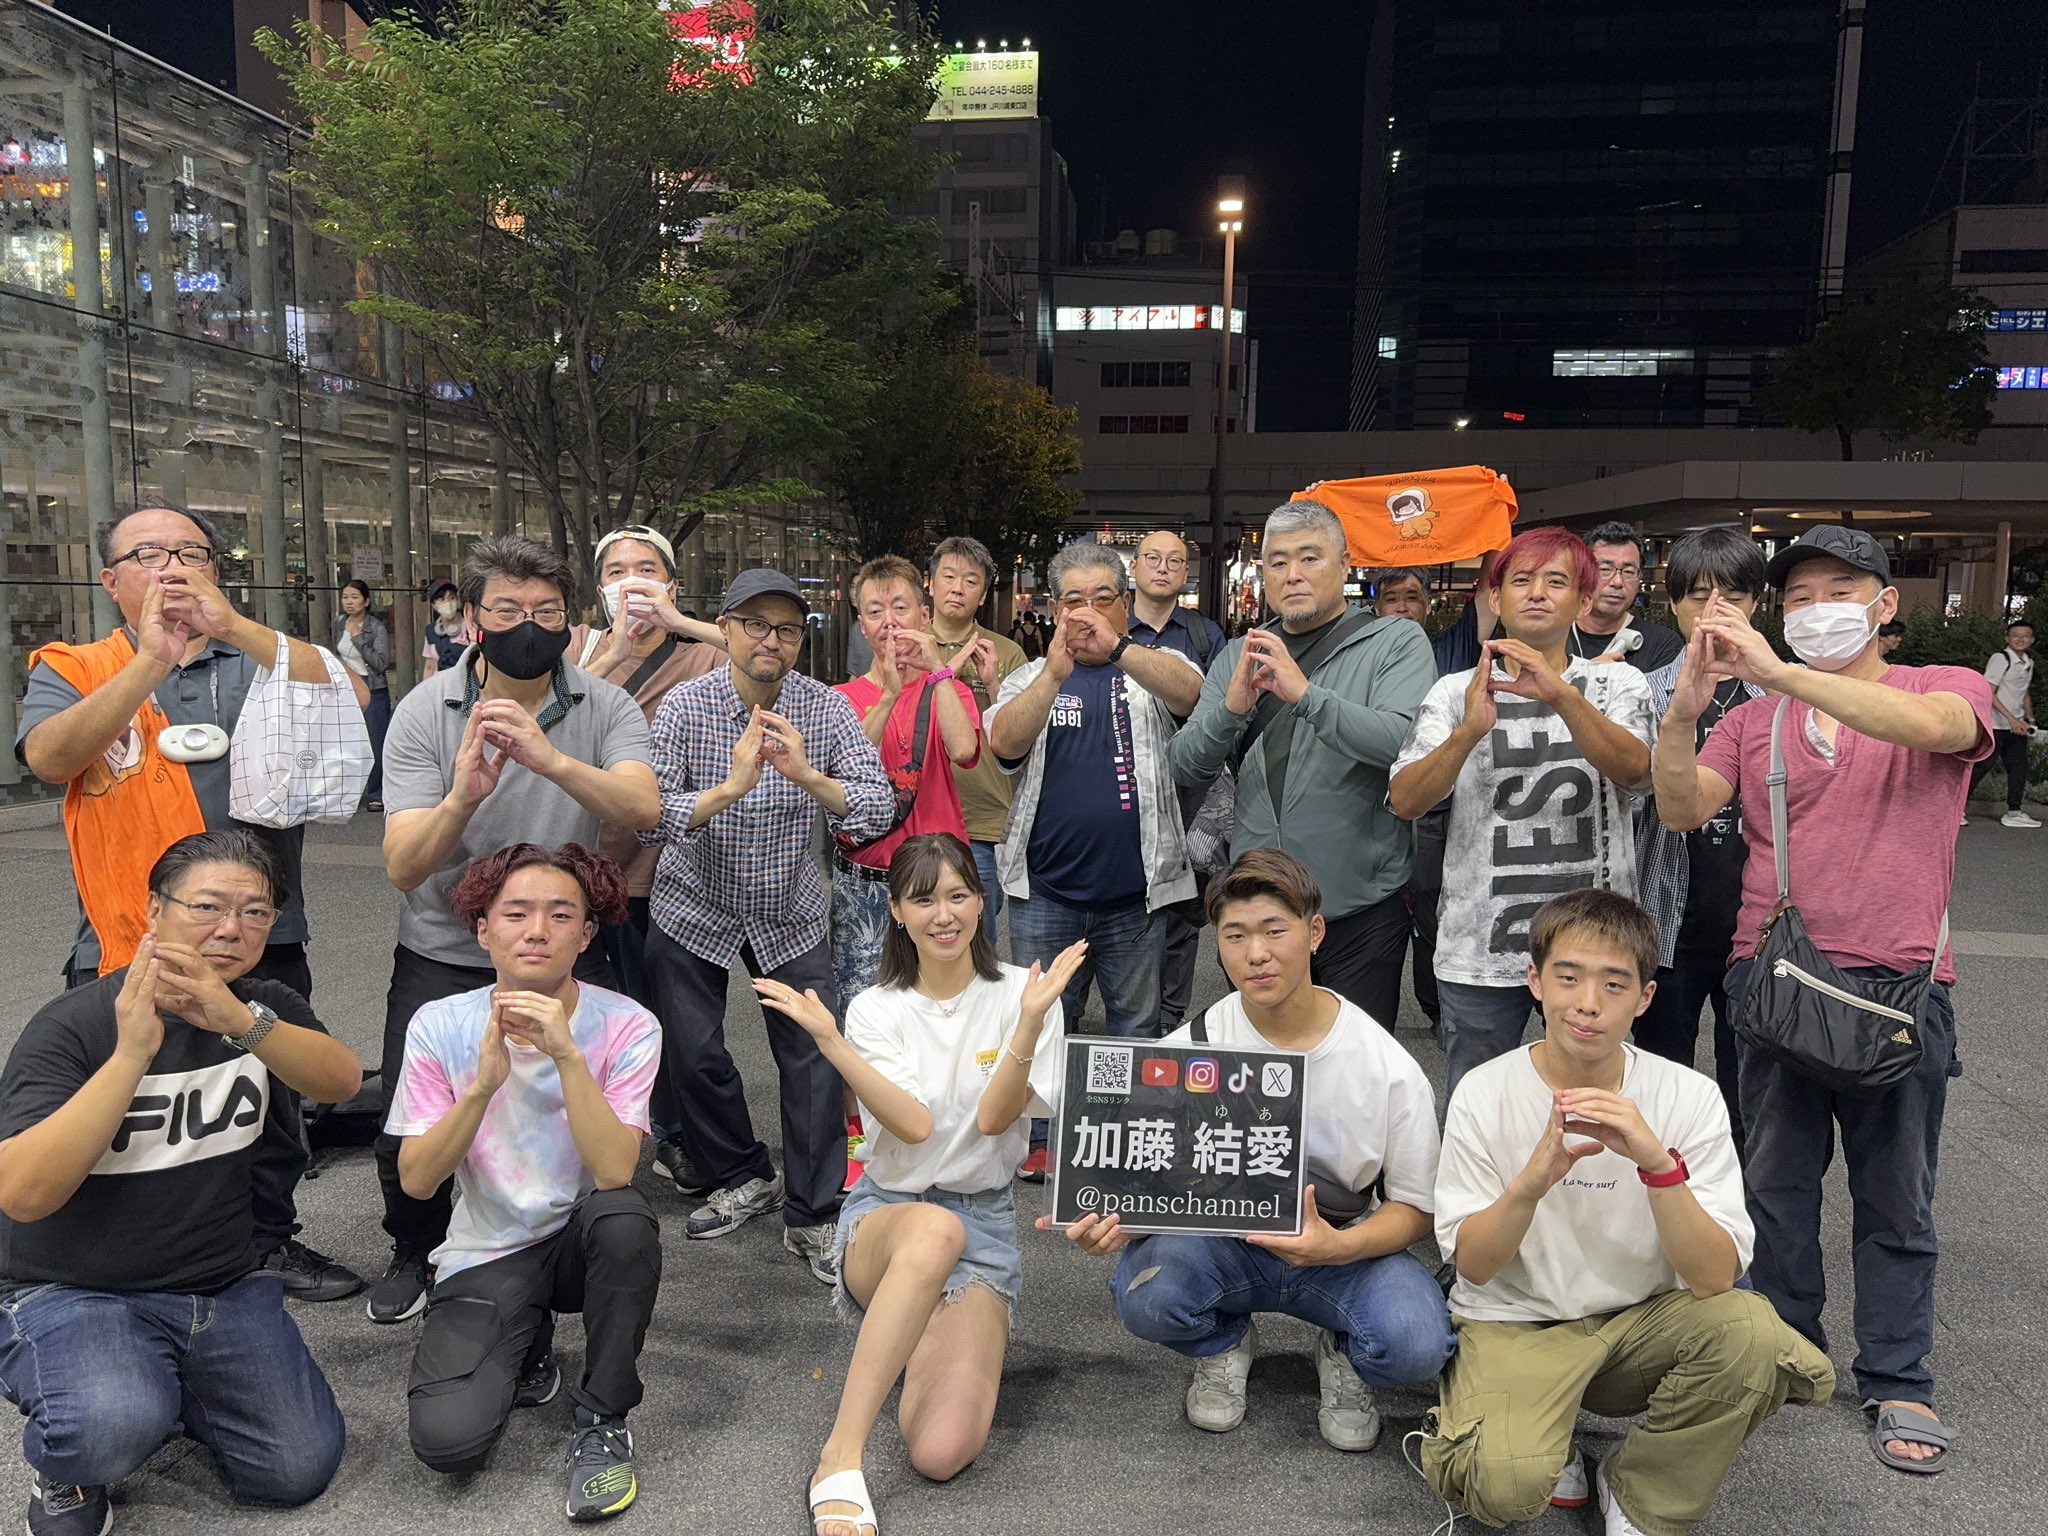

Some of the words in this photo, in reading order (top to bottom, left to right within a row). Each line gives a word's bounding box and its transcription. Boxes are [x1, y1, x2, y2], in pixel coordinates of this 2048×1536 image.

[951, 87, 968, 96] TEL
[969, 85, 1034, 96] 044-245-4888
[1111, 308, 1177, 322] アイフル
[1052, 709, 1082, 728] 1981
[1116, 707, 1127, 734] WITH
[1123, 741, 1137, 792] PASSION
[1086, 1095, 1130, 1105] 全SNSリンク
[111, 1074, 262, 1153] FILA
[1215, 1105, 1228, 1119] ゆ
[1258, 1107, 1272, 1121] あ
[1071, 1116, 1175, 1172] 加藤
[1192, 1122, 1292, 1178] 結愛
[1577, 1180, 1594, 1188] mer
[1596, 1180, 1618, 1190] surf
[1076, 1186, 1280, 1219] @panschannel
